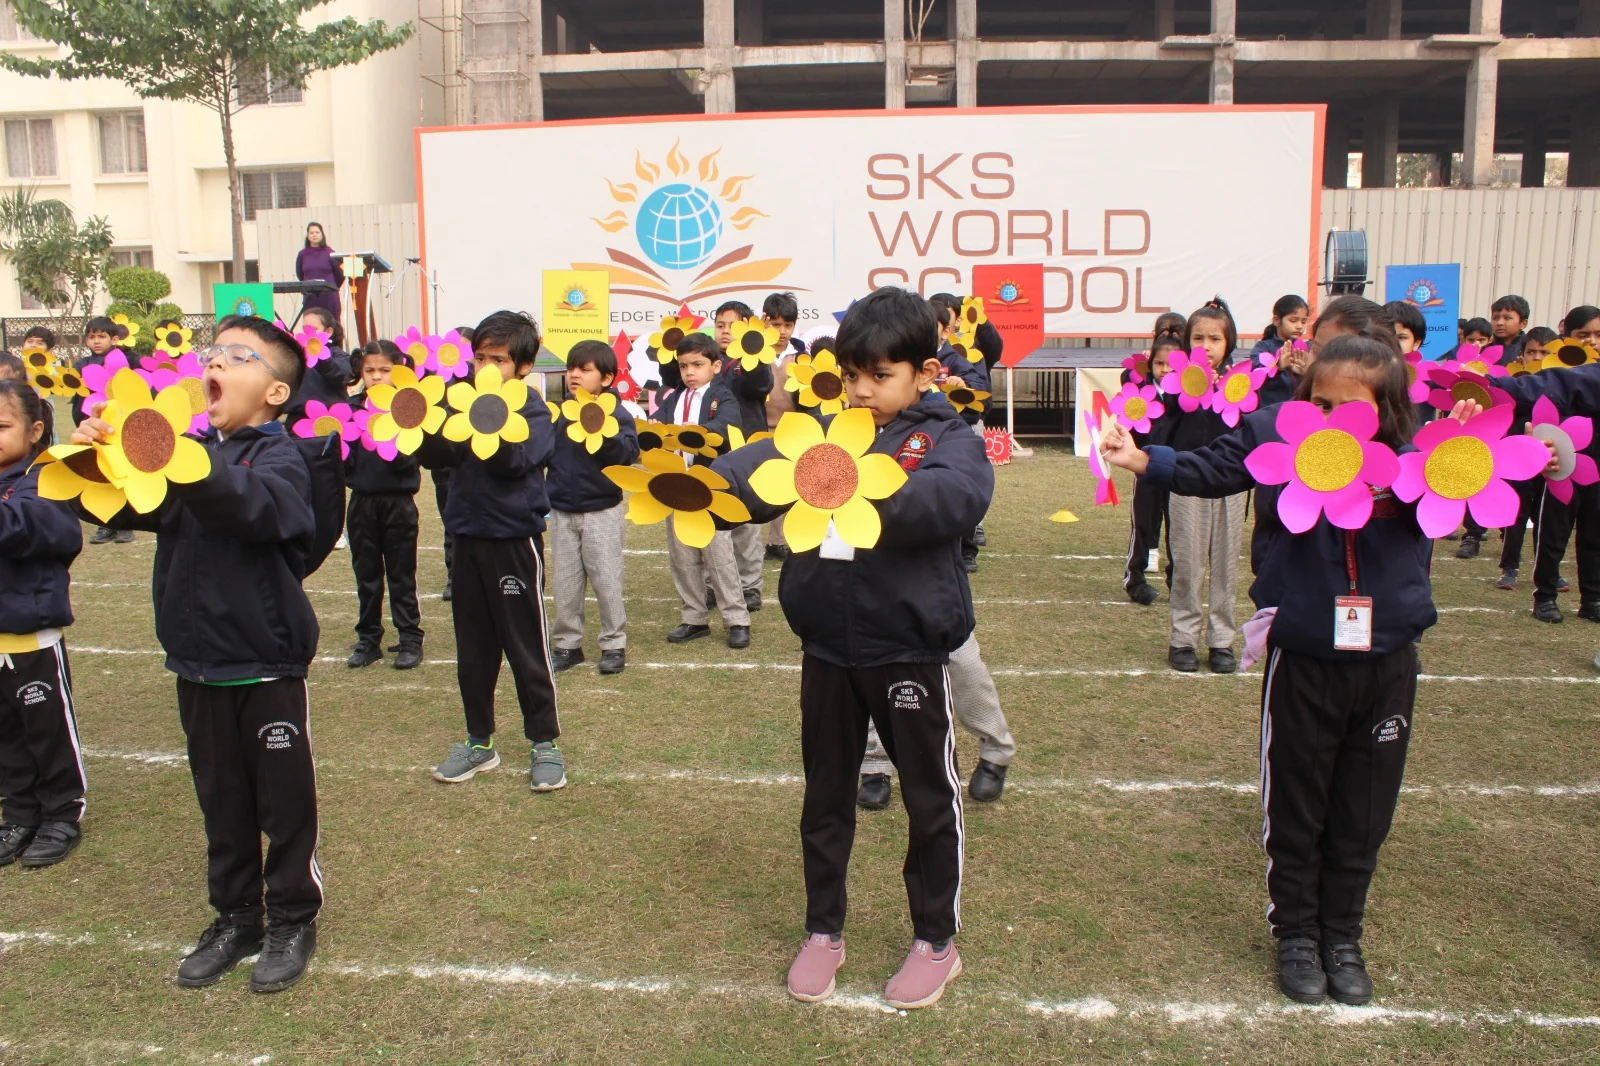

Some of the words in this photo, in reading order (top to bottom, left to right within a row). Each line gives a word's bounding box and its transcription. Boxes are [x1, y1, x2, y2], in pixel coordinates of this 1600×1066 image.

[866, 151, 1015, 200] SKS
[868, 208, 1151, 257] WORLD
[24, 691, 43, 700] WORLD
[896, 694, 919, 702] WORLD
[894, 701, 921, 709] SCHOOL
[1385, 720, 1397, 728] SKS
[1380, 726, 1399, 735] WORLD
[267, 734, 290, 742] WORLD
[266, 741, 291, 749] SCHOOL
